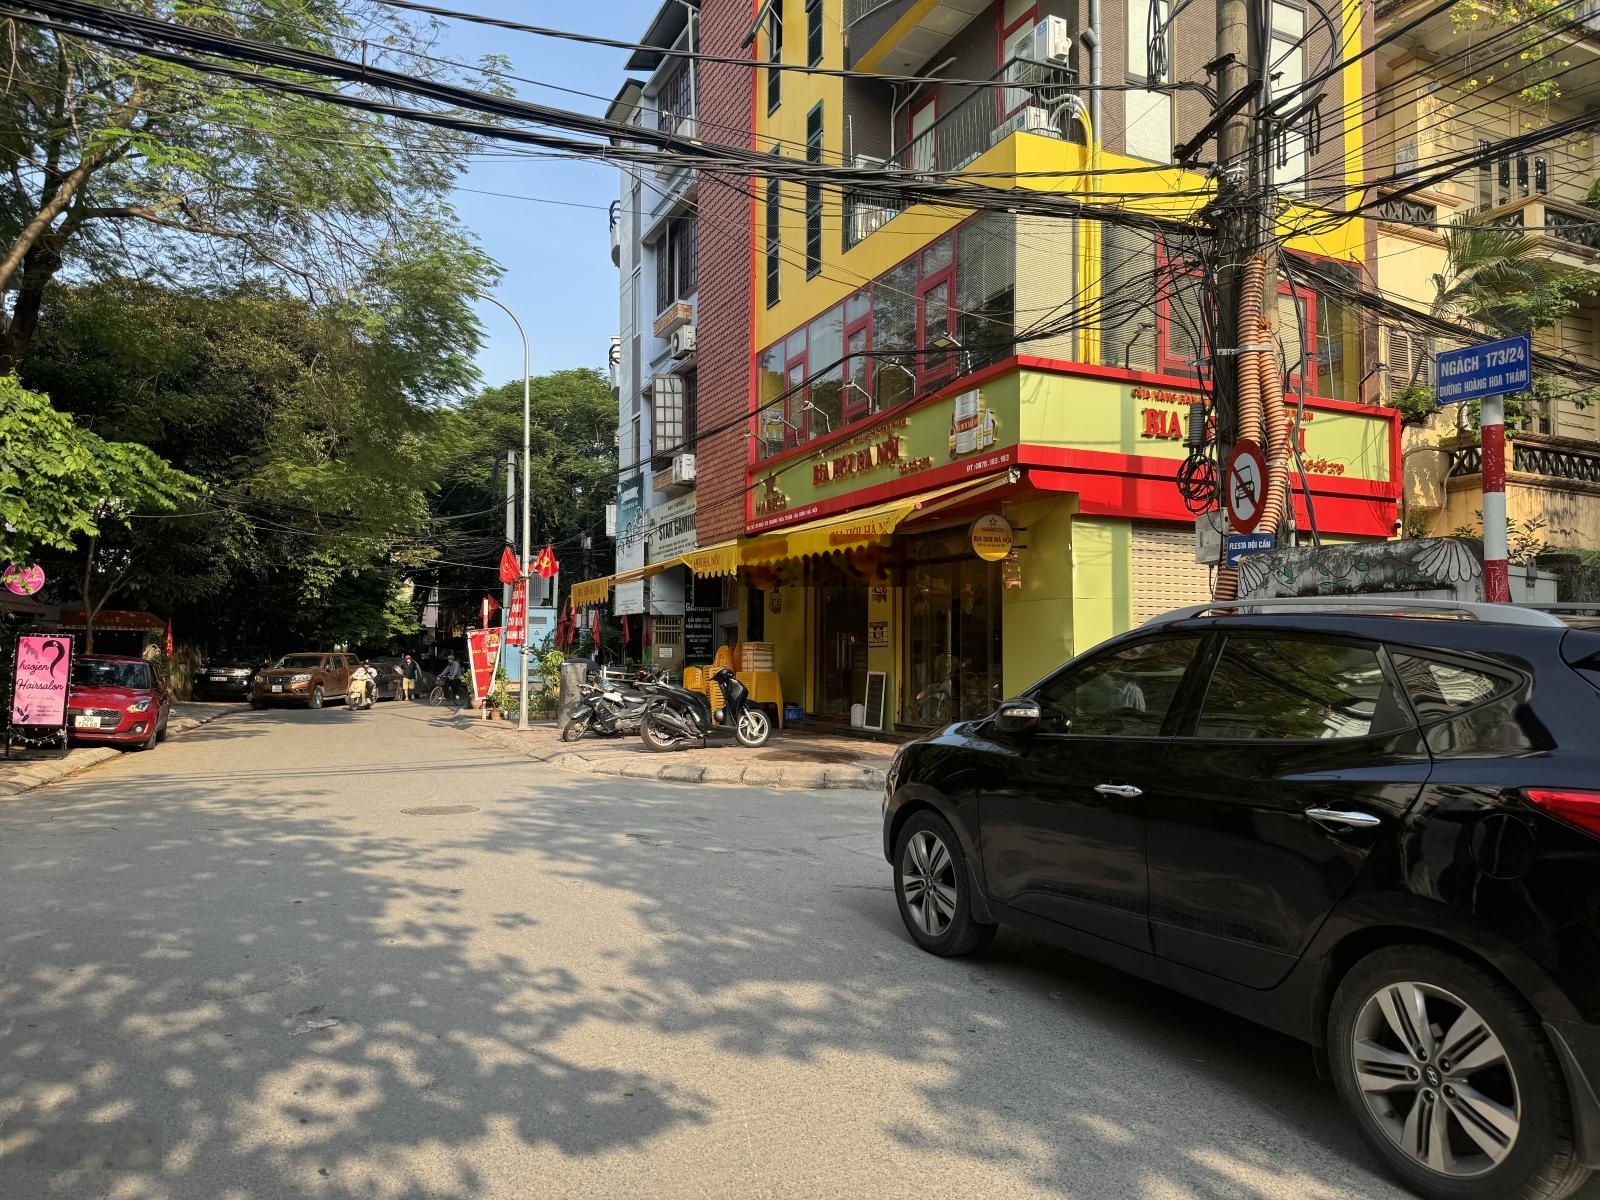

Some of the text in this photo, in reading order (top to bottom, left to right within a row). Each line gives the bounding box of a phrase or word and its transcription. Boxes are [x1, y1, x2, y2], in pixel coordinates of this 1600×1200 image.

[1441, 346, 1524, 377] NGÁCH 173/24
[1464, 378, 1487, 392] HOÀNG
[1489, 375, 1503, 388] HOA
[1505, 369, 1527, 384] THÁM
[1141, 407, 1183, 440] BIA
[1247, 539, 1258, 550] ĐỘI
[16, 679, 65, 691] Hairsalon
